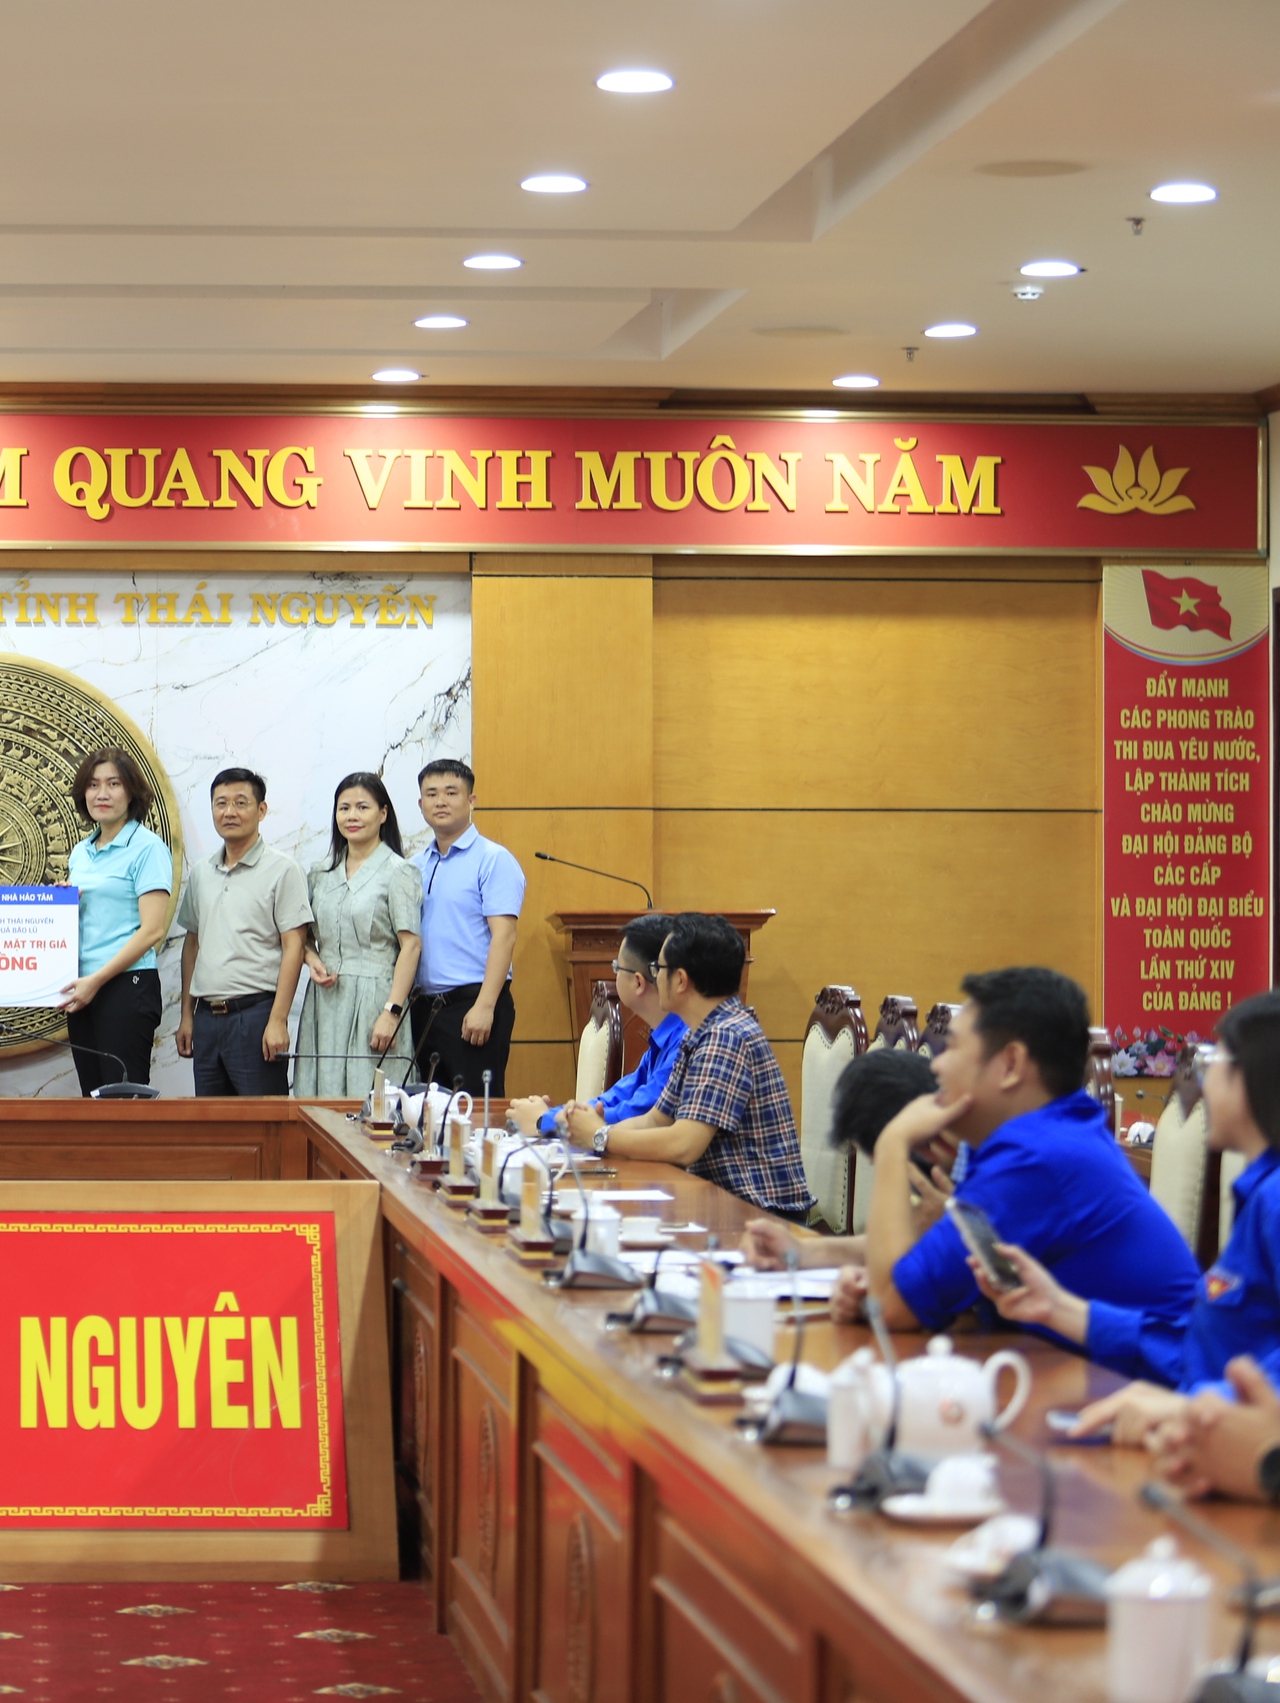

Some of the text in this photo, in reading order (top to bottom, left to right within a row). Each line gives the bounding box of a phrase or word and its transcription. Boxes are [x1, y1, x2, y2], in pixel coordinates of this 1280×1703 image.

[52, 445, 324, 521] QUANG
[344, 447, 553, 511] VINH
[574, 435, 804, 513] MUÔN
[824, 437, 1003, 516] NĂM
[113, 581, 234, 625] THÁI
[248, 584, 438, 626] NGUYÊN
[1145, 669, 1229, 702] ĐẨY MẠNH
[1120, 704, 1255, 730] CÁC PHONG TRÀO
[1114, 735, 1261, 763] THI ĐUA YÊU NƯỚC,
[1124, 767, 1250, 796] LẬP THÀNH TÍCH
[1140, 798, 1235, 823] CHÀO MỪNG
[1121, 826, 1253, 859] ĐẠI HỘI ĐẢNG BỘ
[1153, 859, 1222, 886] CÁC CẤP
[1110, 889, 1264, 922] VÀ ĐẠI HỘI ĐẠI BIỂU
[3, 938, 27, 952] MẶT
[30, 939, 47, 952] TRỊ
[49, 938, 67, 949] GIÁ
[1143, 922, 1232, 951] TOÀN QUỐC
[1140, 953, 1235, 980] LẦN THỨ XIV
[1142, 983, 1175, 1012] CỦA
[1178, 983, 1222, 1011] ĐẢNG
[19, 1291, 303, 1431] NGUYÊN
